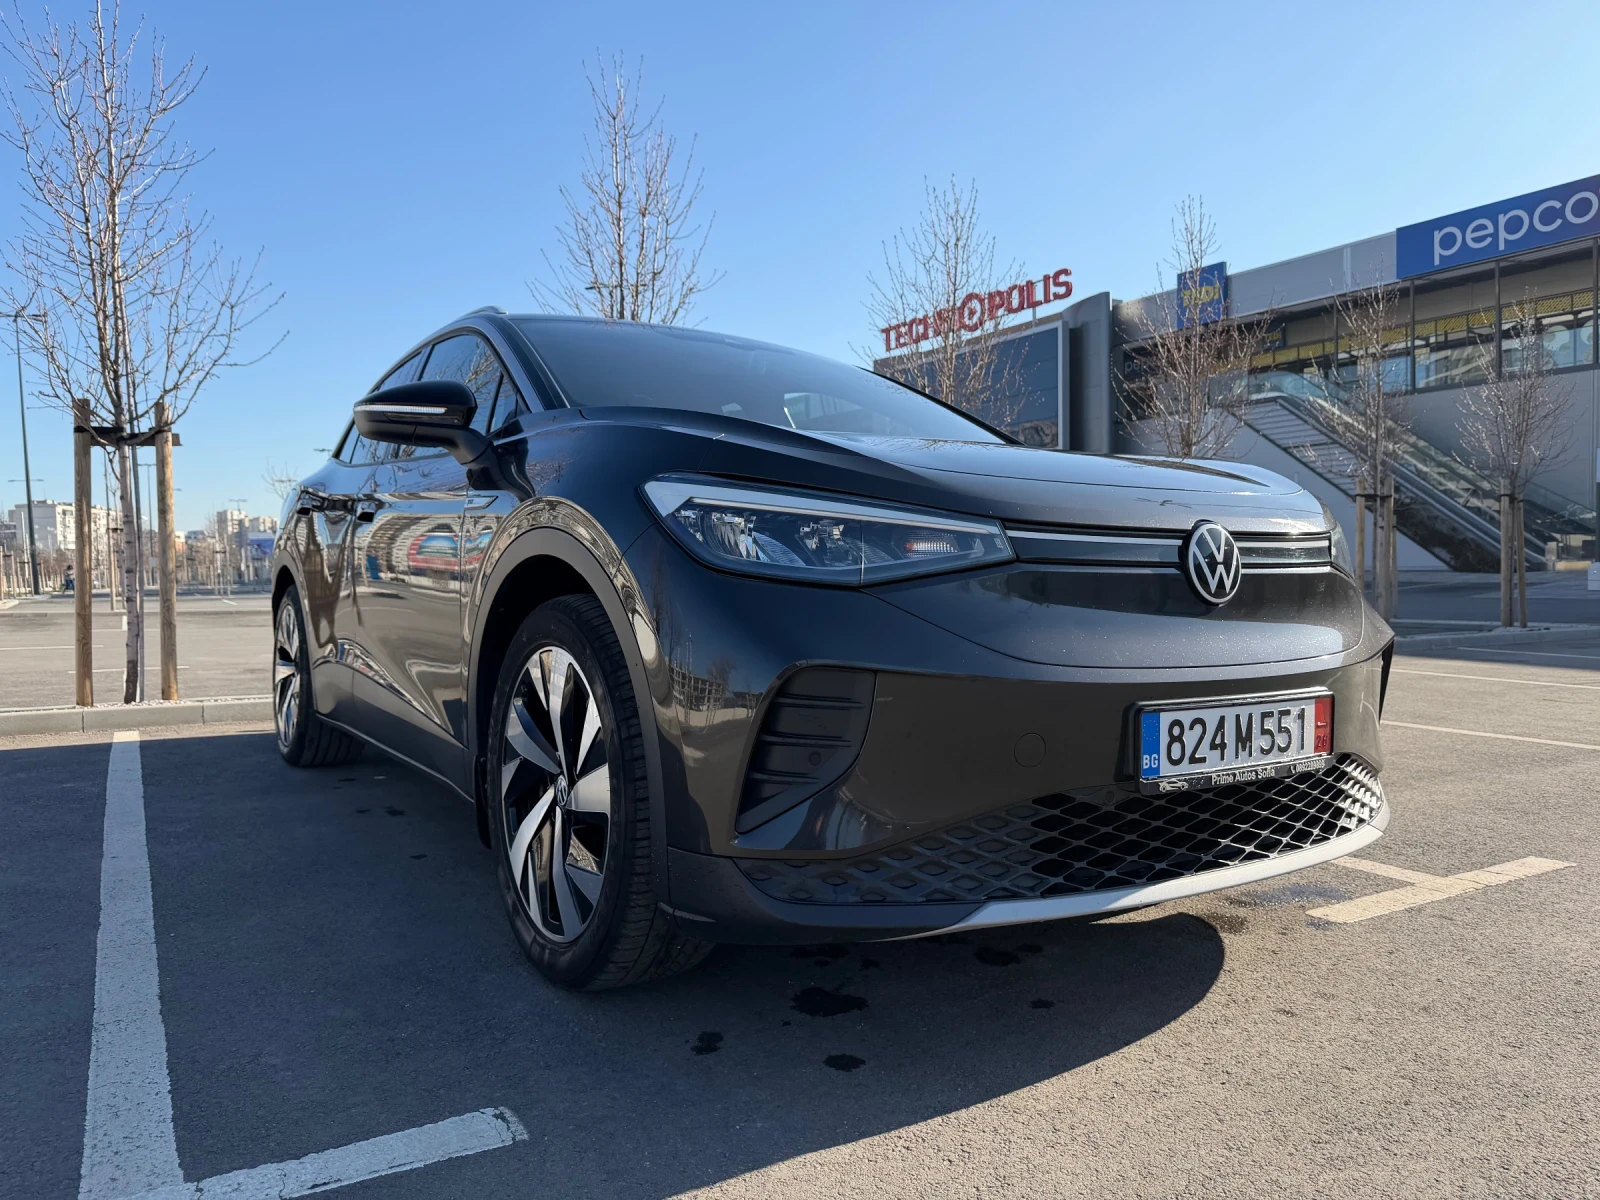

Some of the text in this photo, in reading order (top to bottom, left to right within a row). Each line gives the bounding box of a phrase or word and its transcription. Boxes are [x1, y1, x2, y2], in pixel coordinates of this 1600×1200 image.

[1433, 191, 1599, 266] pepco
[1142, 753, 1159, 769] BG
[1211, 766, 1275, 786] Prime Autos Sofia
